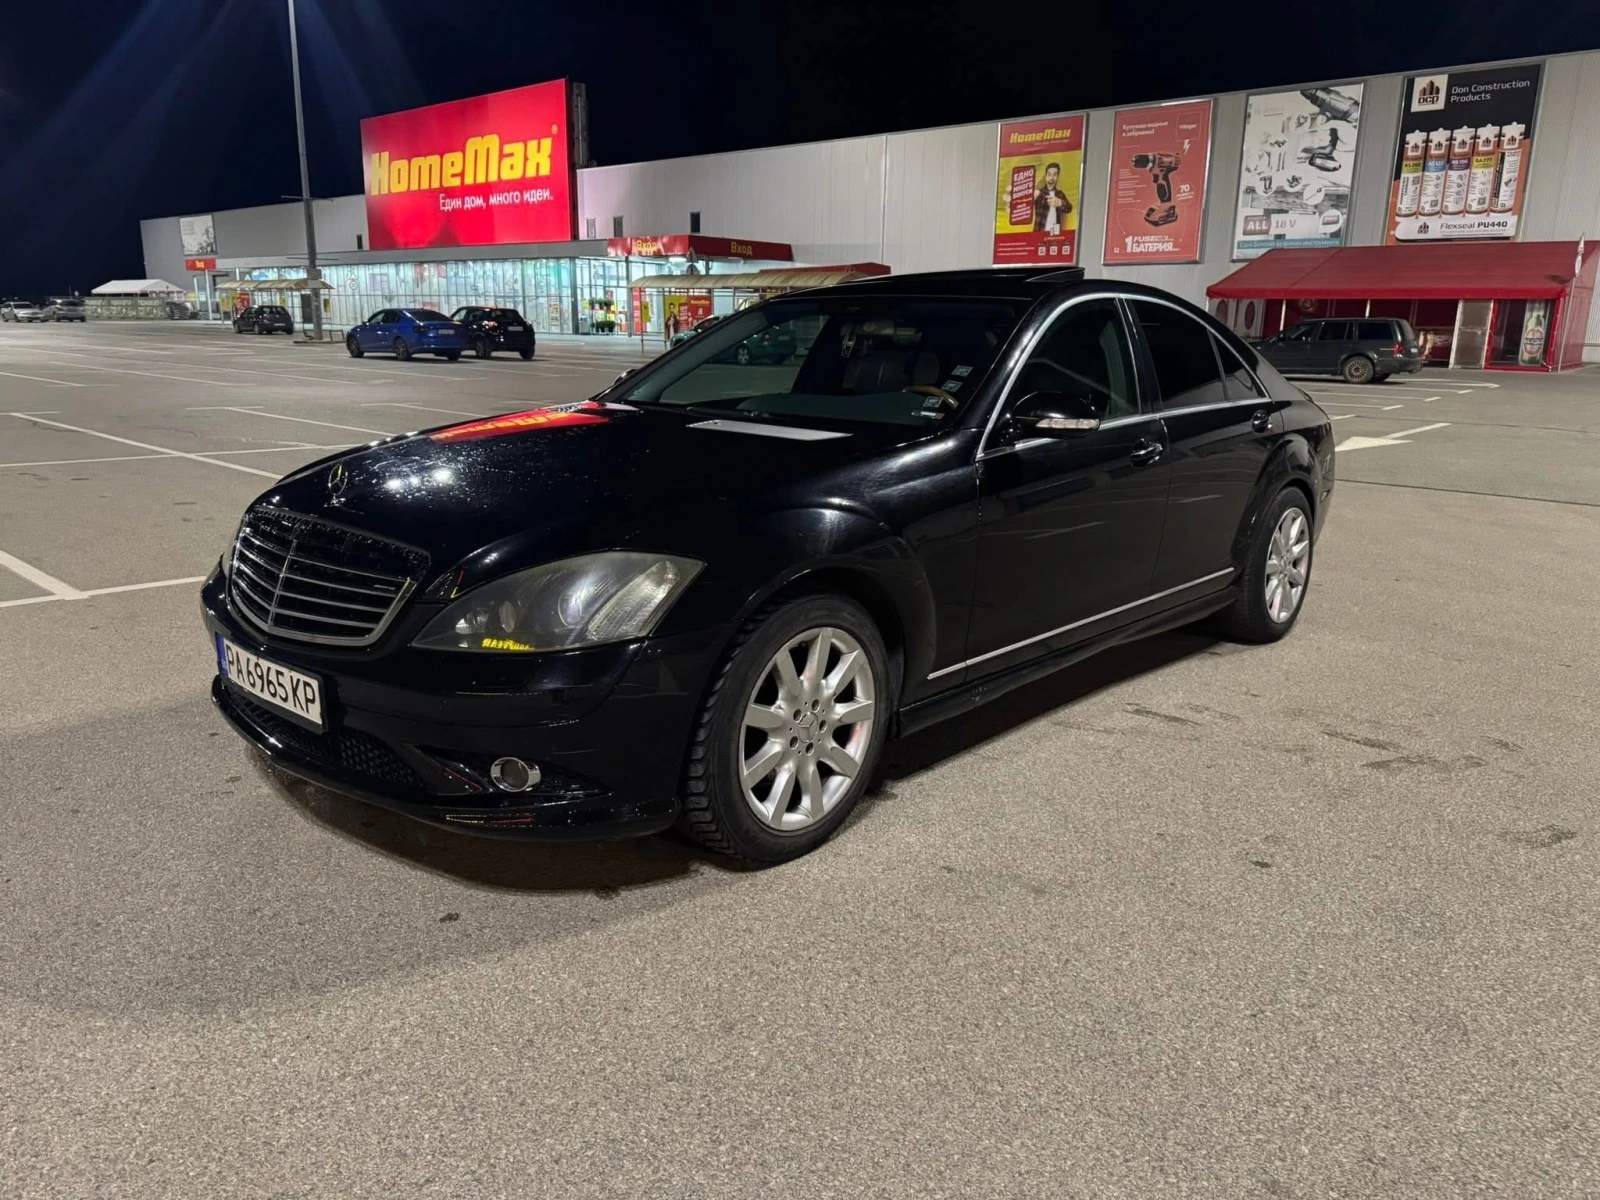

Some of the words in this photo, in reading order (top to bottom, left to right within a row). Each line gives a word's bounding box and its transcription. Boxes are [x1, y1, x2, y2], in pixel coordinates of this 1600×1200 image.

[1451, 86, 1470, 95] Don
[1471, 79, 1531, 93] Construction
[1450, 92, 1491, 103] Products
[1009, 128, 1071, 144] HomeMax
[371, 133, 552, 196] HomeMax
[1013, 169, 1034, 182] ЕДНО
[1179, 184, 1190, 192] 70
[439, 193, 462, 212] Един
[463, 194, 487, 210] дом,
[489, 190, 521, 205] много
[523, 187, 553, 204] идеи.
[1246, 220, 1269, 231] ALL
[1274, 220, 1287, 229] 18
[1289, 219, 1297, 228] V
[1440, 222, 1475, 230] Flexseal
[1477, 220, 1508, 229] PU440
[636, 240, 658, 252] Вход
[730, 241, 753, 255] Вход
[1124, 235, 1133, 253] 1
[1132, 241, 1174, 253] БАТЕРИЯ
[225, 643, 316, 714] PA6965KP
